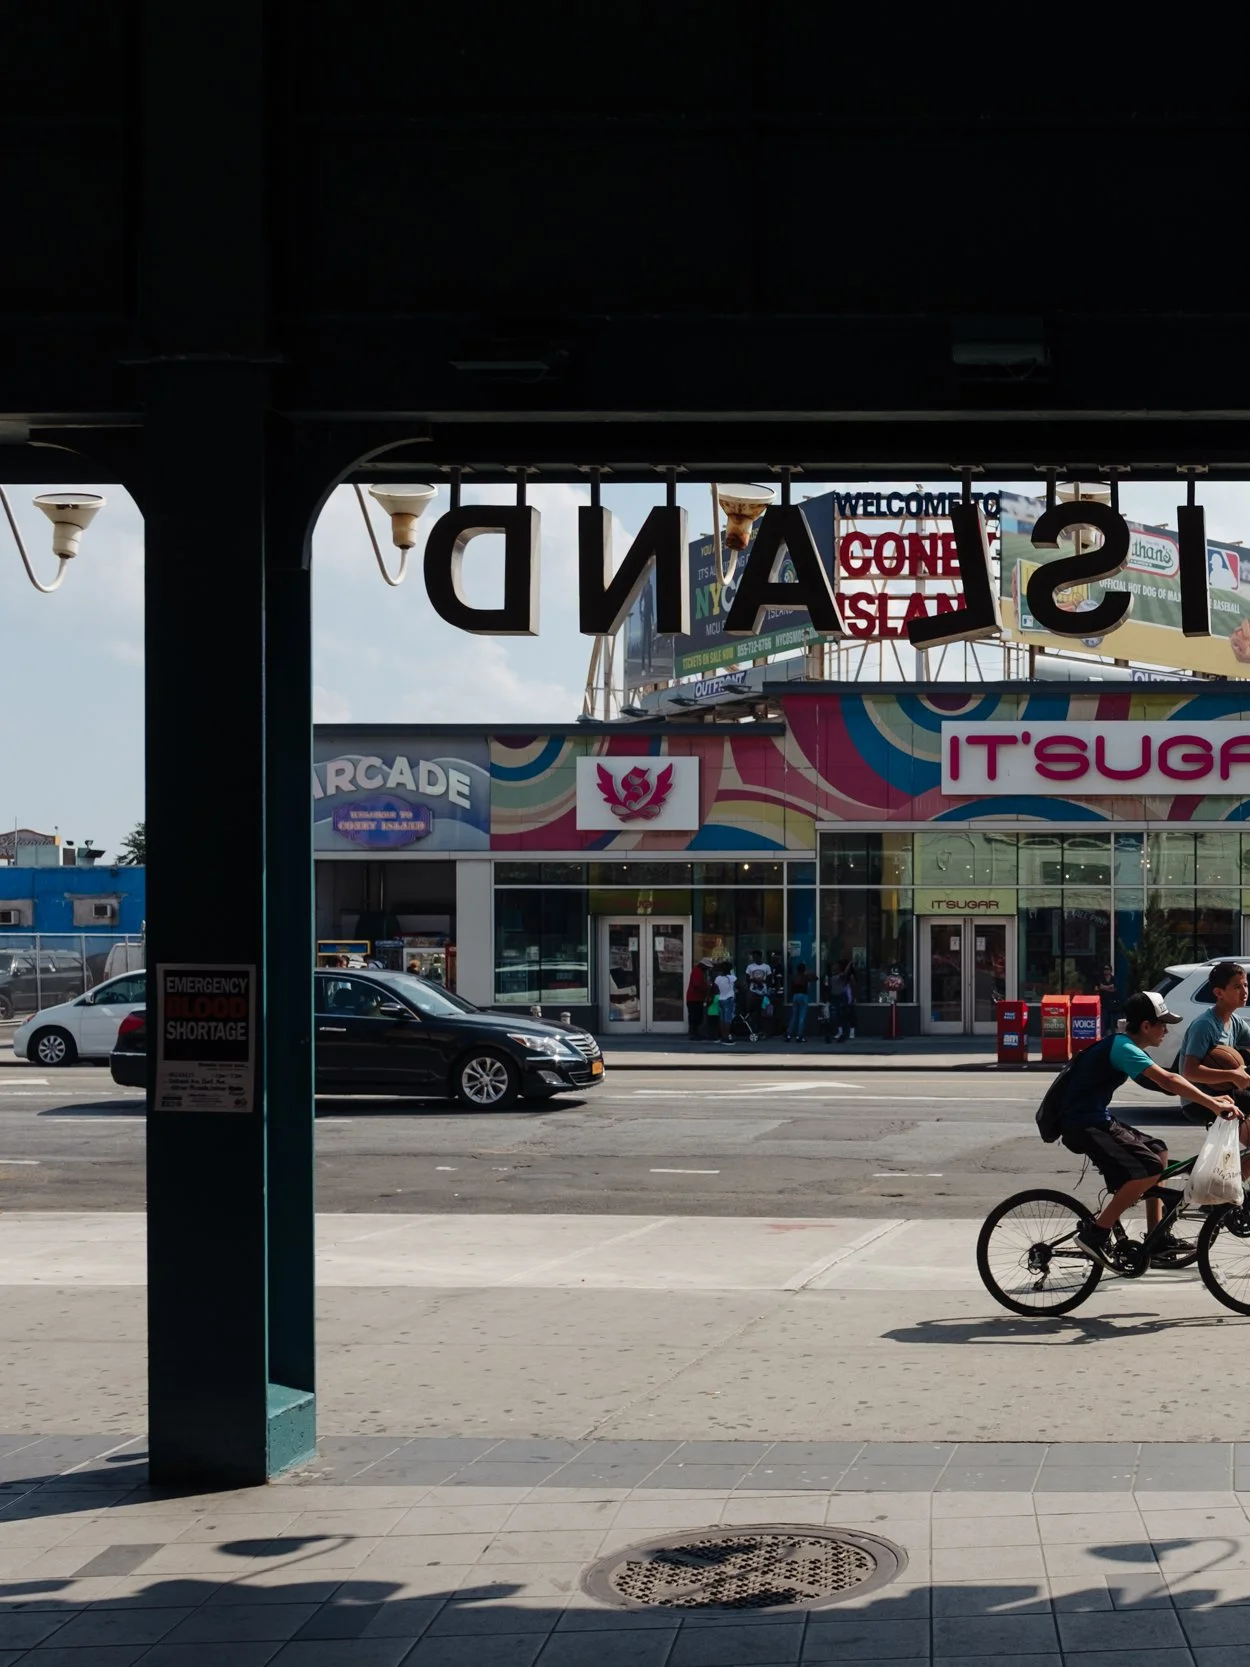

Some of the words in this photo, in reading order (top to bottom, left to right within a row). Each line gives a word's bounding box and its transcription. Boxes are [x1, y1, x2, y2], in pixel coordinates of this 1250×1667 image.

[835, 491, 960, 517] WELCOME
[839, 531, 997, 577] CONE
[1131, 538, 1173, 564] than's
[1100, 578, 1127, 592] OFFICIAL
[1128, 582, 1141, 594] HOT
[1143, 585, 1157, 598] DOG
[1158, 588, 1167, 600] OF
[836, 592, 967, 637] ISLA
[1213, 599, 1240, 614] BASEBALL
[931, 900, 999, 909] IT'SUGAR
[166, 976, 248, 994] EMERGENCY
[166, 997, 247, 1018] BLOOD
[166, 1020, 247, 1041] SHORTAGE
